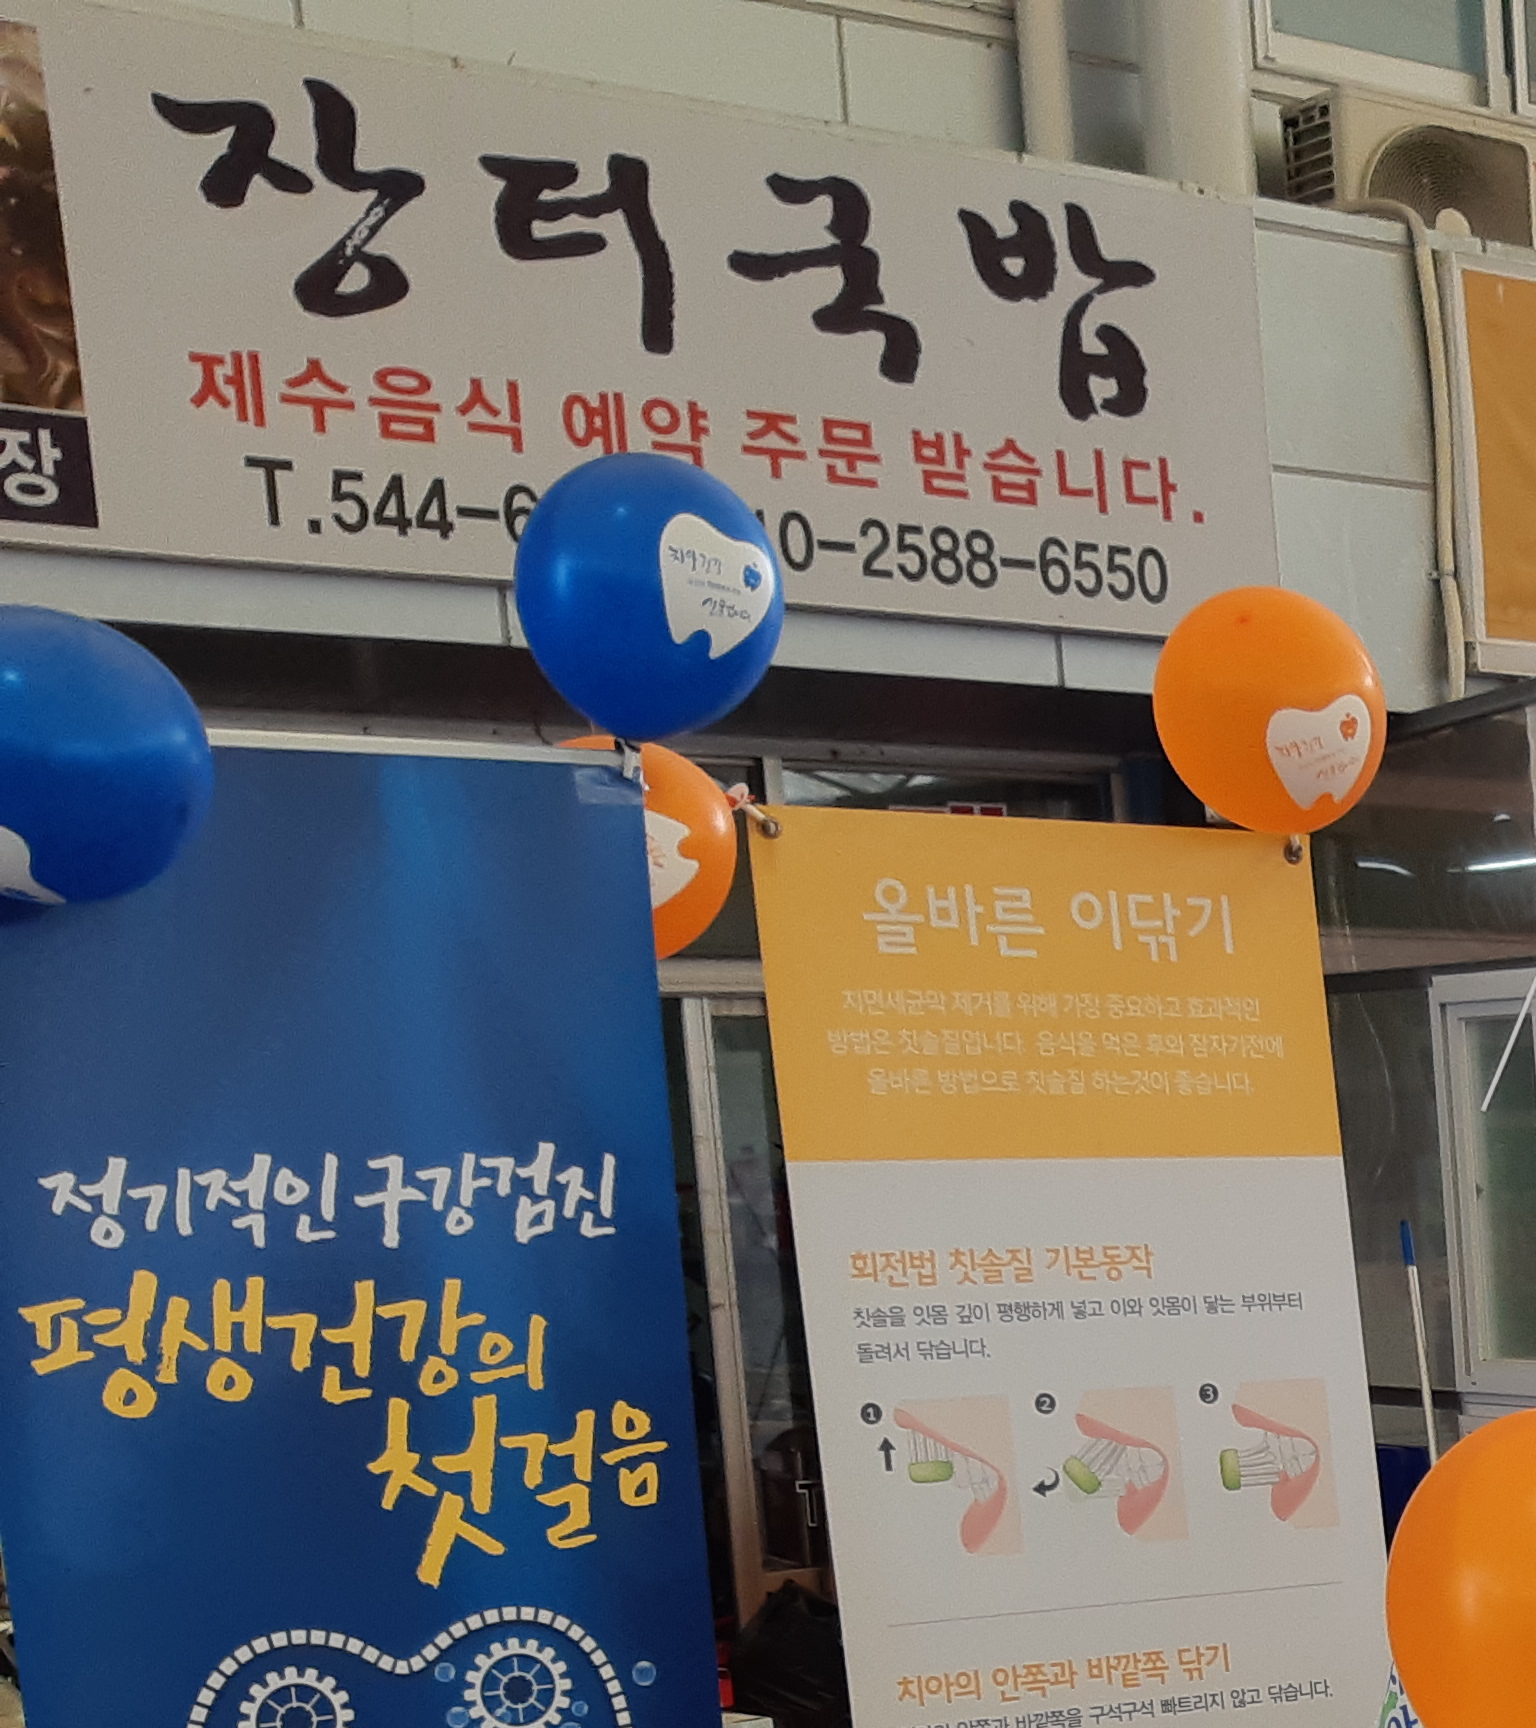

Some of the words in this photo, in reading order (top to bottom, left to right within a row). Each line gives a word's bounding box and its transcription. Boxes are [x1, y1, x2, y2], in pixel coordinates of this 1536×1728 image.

[150, 78, 1157, 421] 장터국밥
[189, 349, 527, 453] 제수음식
[562, 390, 711, 465] 예약
[741, 412, 882, 489] 주문
[911, 427, 1206, 525] 받습니다.
[863, 877, 1045, 959] 올바른
[1070, 889, 1235, 962] 이닦기
[39, 1152, 338, 1250] 정기적인
[354, 1142, 617, 1248] 구강검진
[848, 1249, 938, 1288] 회전법
[948, 1247, 1034, 1285] 칫솔질
[1044, 1243, 1154, 1282] 기본동작
[852, 1306, 906, 1329] 칫솔을
[912, 1304, 949, 1327] 잇몸
[955, 1302, 991, 1326] 깊이
[996, 1299, 1066, 1323] 평행하게
[1111, 1296, 1145, 1319] 이와
[1149, 1294, 1198, 1317] 잇몸이
[1241, 1291, 1304, 1314] 부위부터
[855, 1341, 910, 1364] 돌려서
[915, 1338, 992, 1361] 닦습니다.
[367, 1395, 669, 1588] 첫걸음
[897, 1670, 981, 1707] 치아의
[991, 1660, 1077, 1702] 안쪽과
[1086, 1651, 1170, 1691] 바깥쪽
[1177, 1642, 1231, 1683] 닦기
[1089, 1700, 1155, 1726] 구석구석
[1230, 1687, 1262, 1709] 않고
[1267, 1679, 1334, 1704] 닦습니다.
